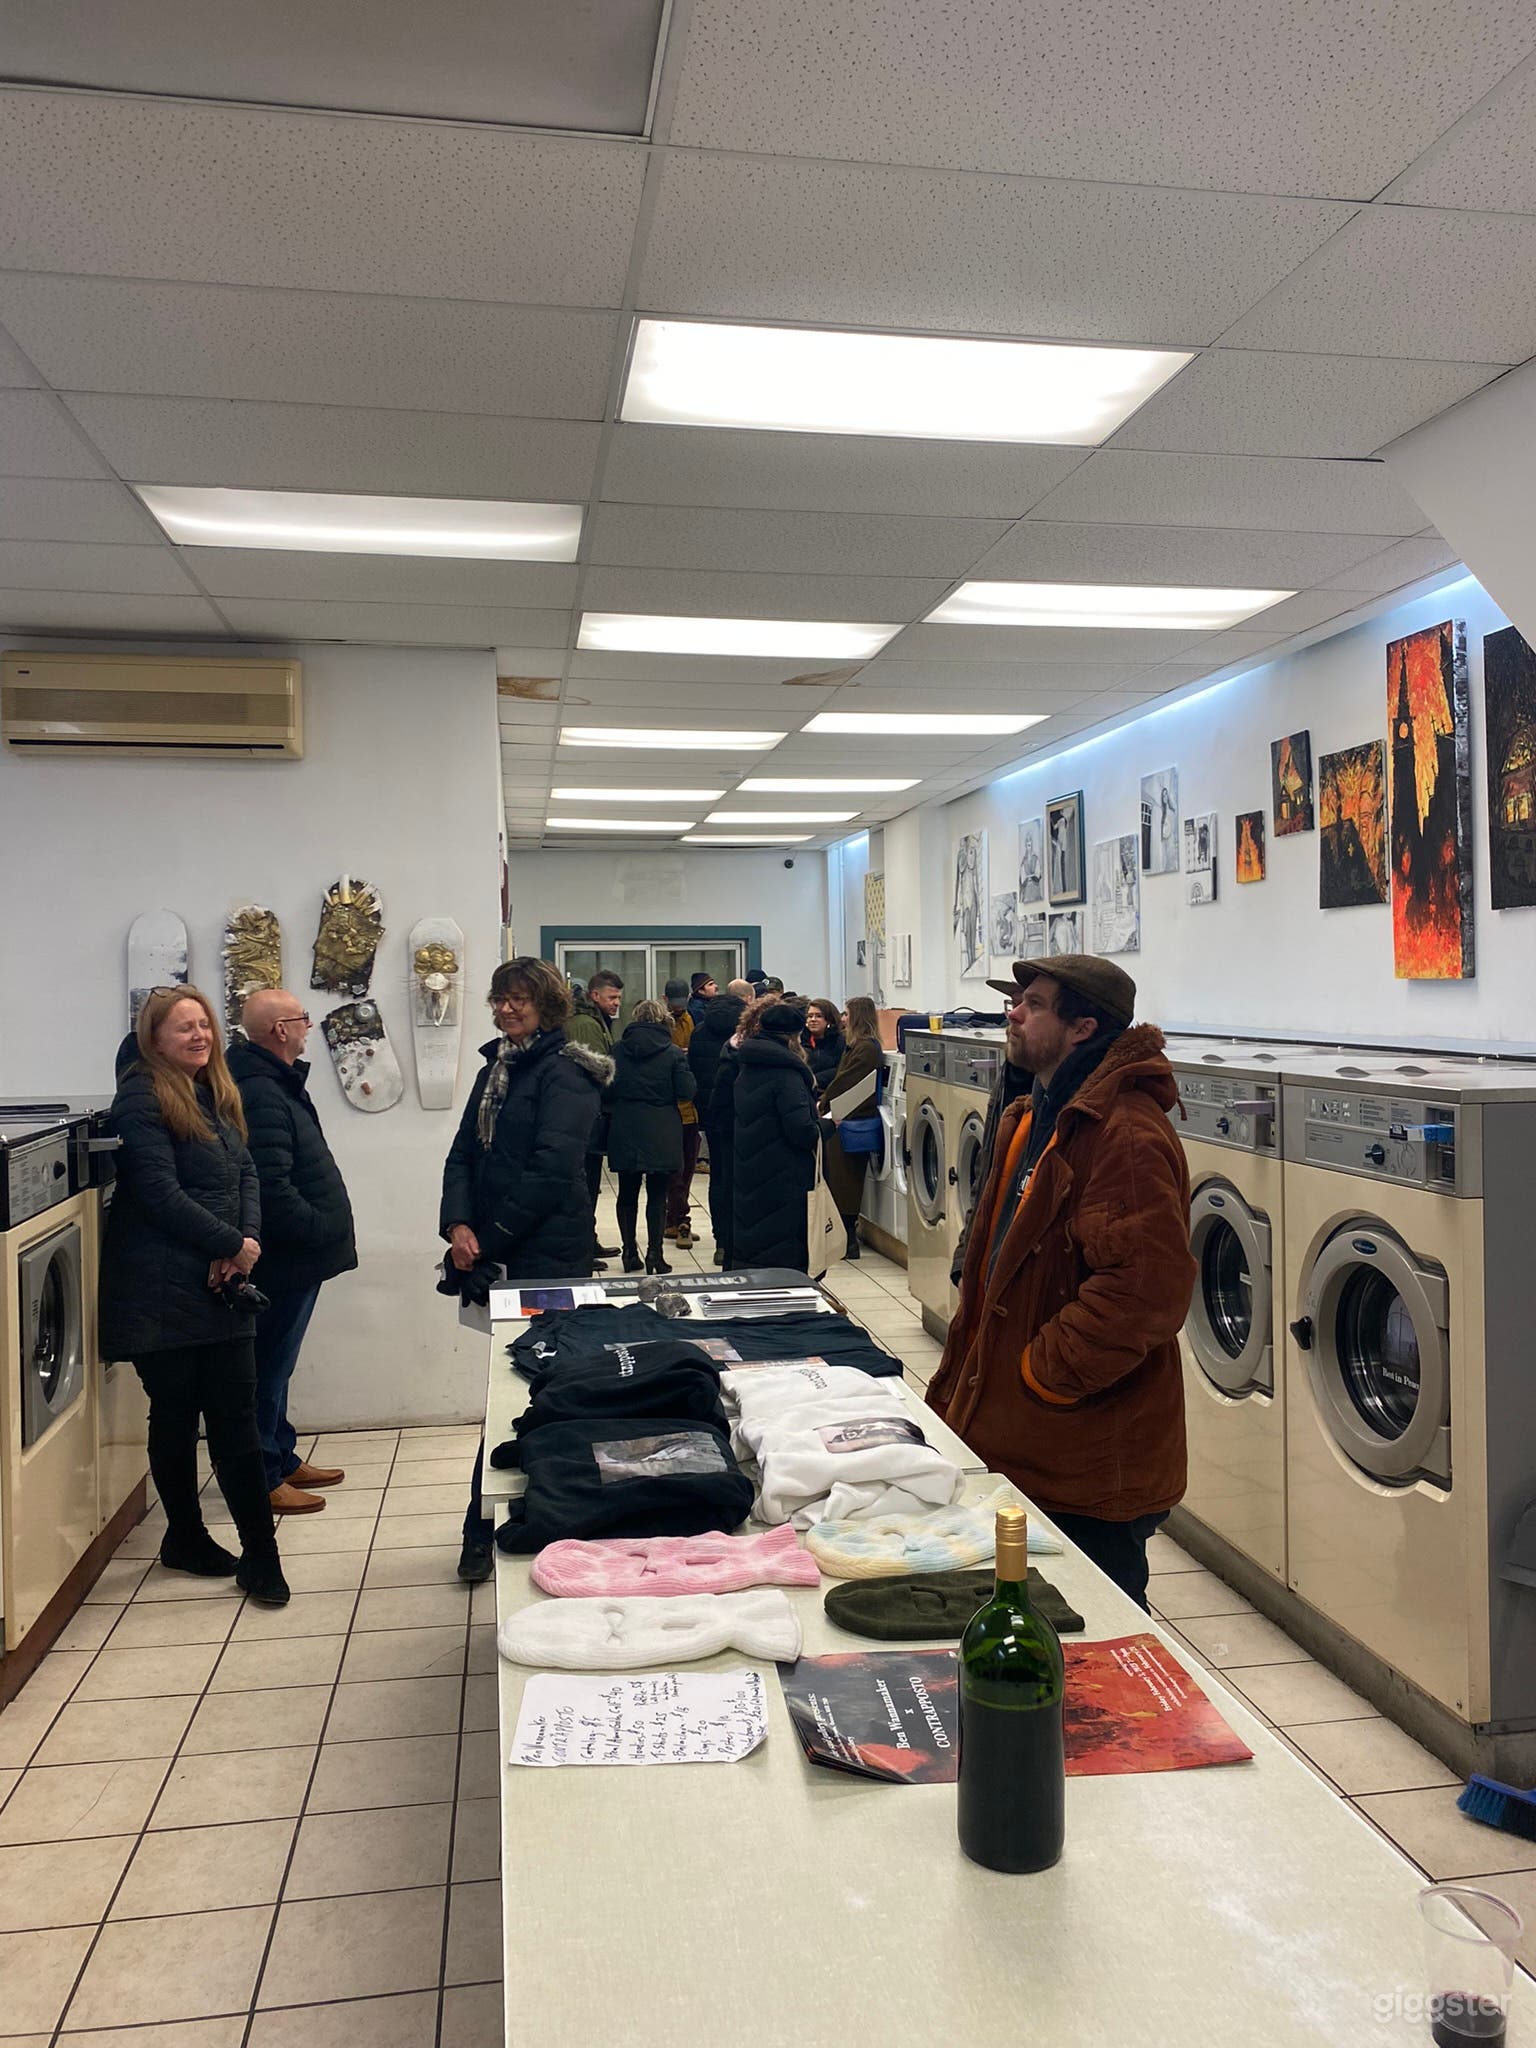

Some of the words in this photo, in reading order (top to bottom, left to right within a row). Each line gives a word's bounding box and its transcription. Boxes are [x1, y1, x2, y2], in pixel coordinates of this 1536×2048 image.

[875, 1679, 903, 1732] Wannamaker
[909, 1676, 951, 1748] CONTRAPPOSTO
[896, 1732, 911, 1749] Ben
